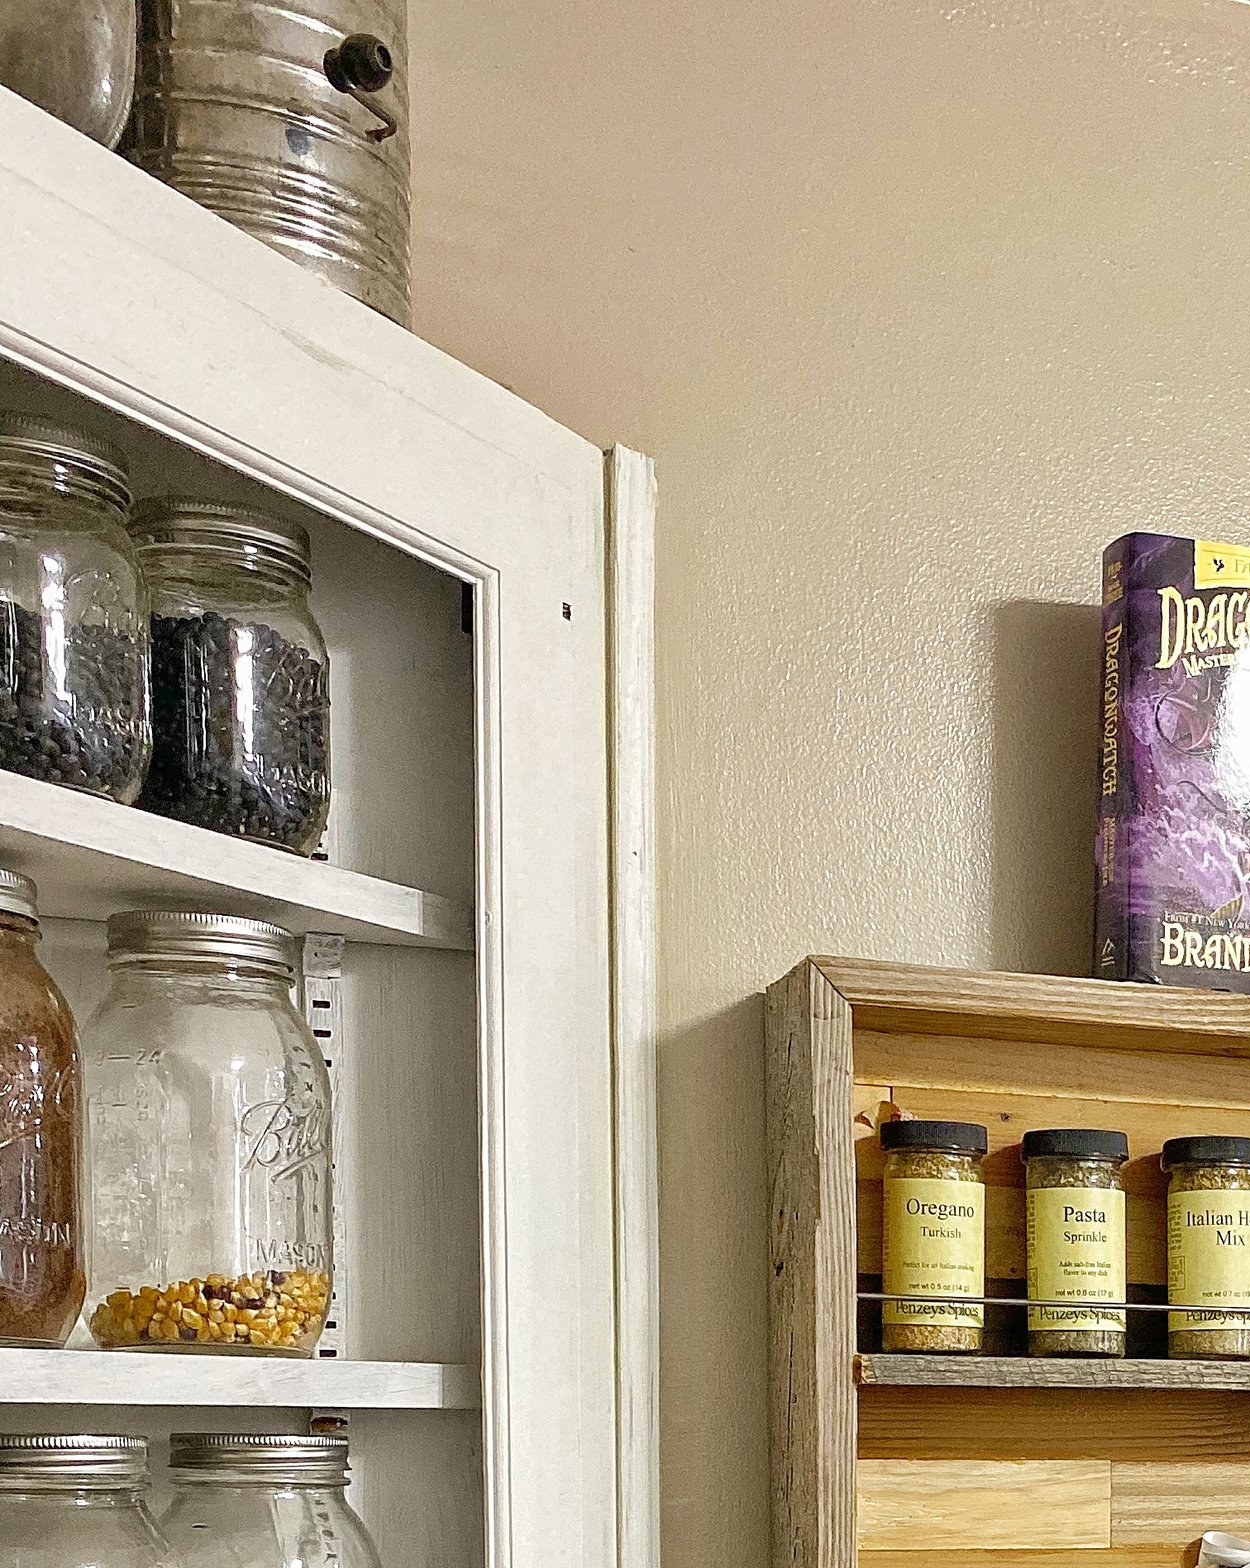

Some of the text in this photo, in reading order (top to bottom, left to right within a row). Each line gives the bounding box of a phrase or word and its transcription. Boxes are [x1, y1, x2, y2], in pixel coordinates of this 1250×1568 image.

[1102, 622, 1124, 797] DRAGONWATCH
[1164, 911, 1190, 925] FROM
[1205, 915, 1226, 929] NEW
[1228, 918, 1250, 931] YORK
[906, 1198, 975, 1221] Oregano
[1063, 1206, 1107, 1223] Pasta
[1186, 1210, 1233, 1227] Italian
[920, 1226, 962, 1239] Turkish
[1063, 1231, 1107, 1244] Sprinkle
[1215, 1229, 1246, 1246] Mix
[896, 1300, 979, 1319] Penzeys Spices
[1040, 1306, 1120, 1324] Penzeys Spices
